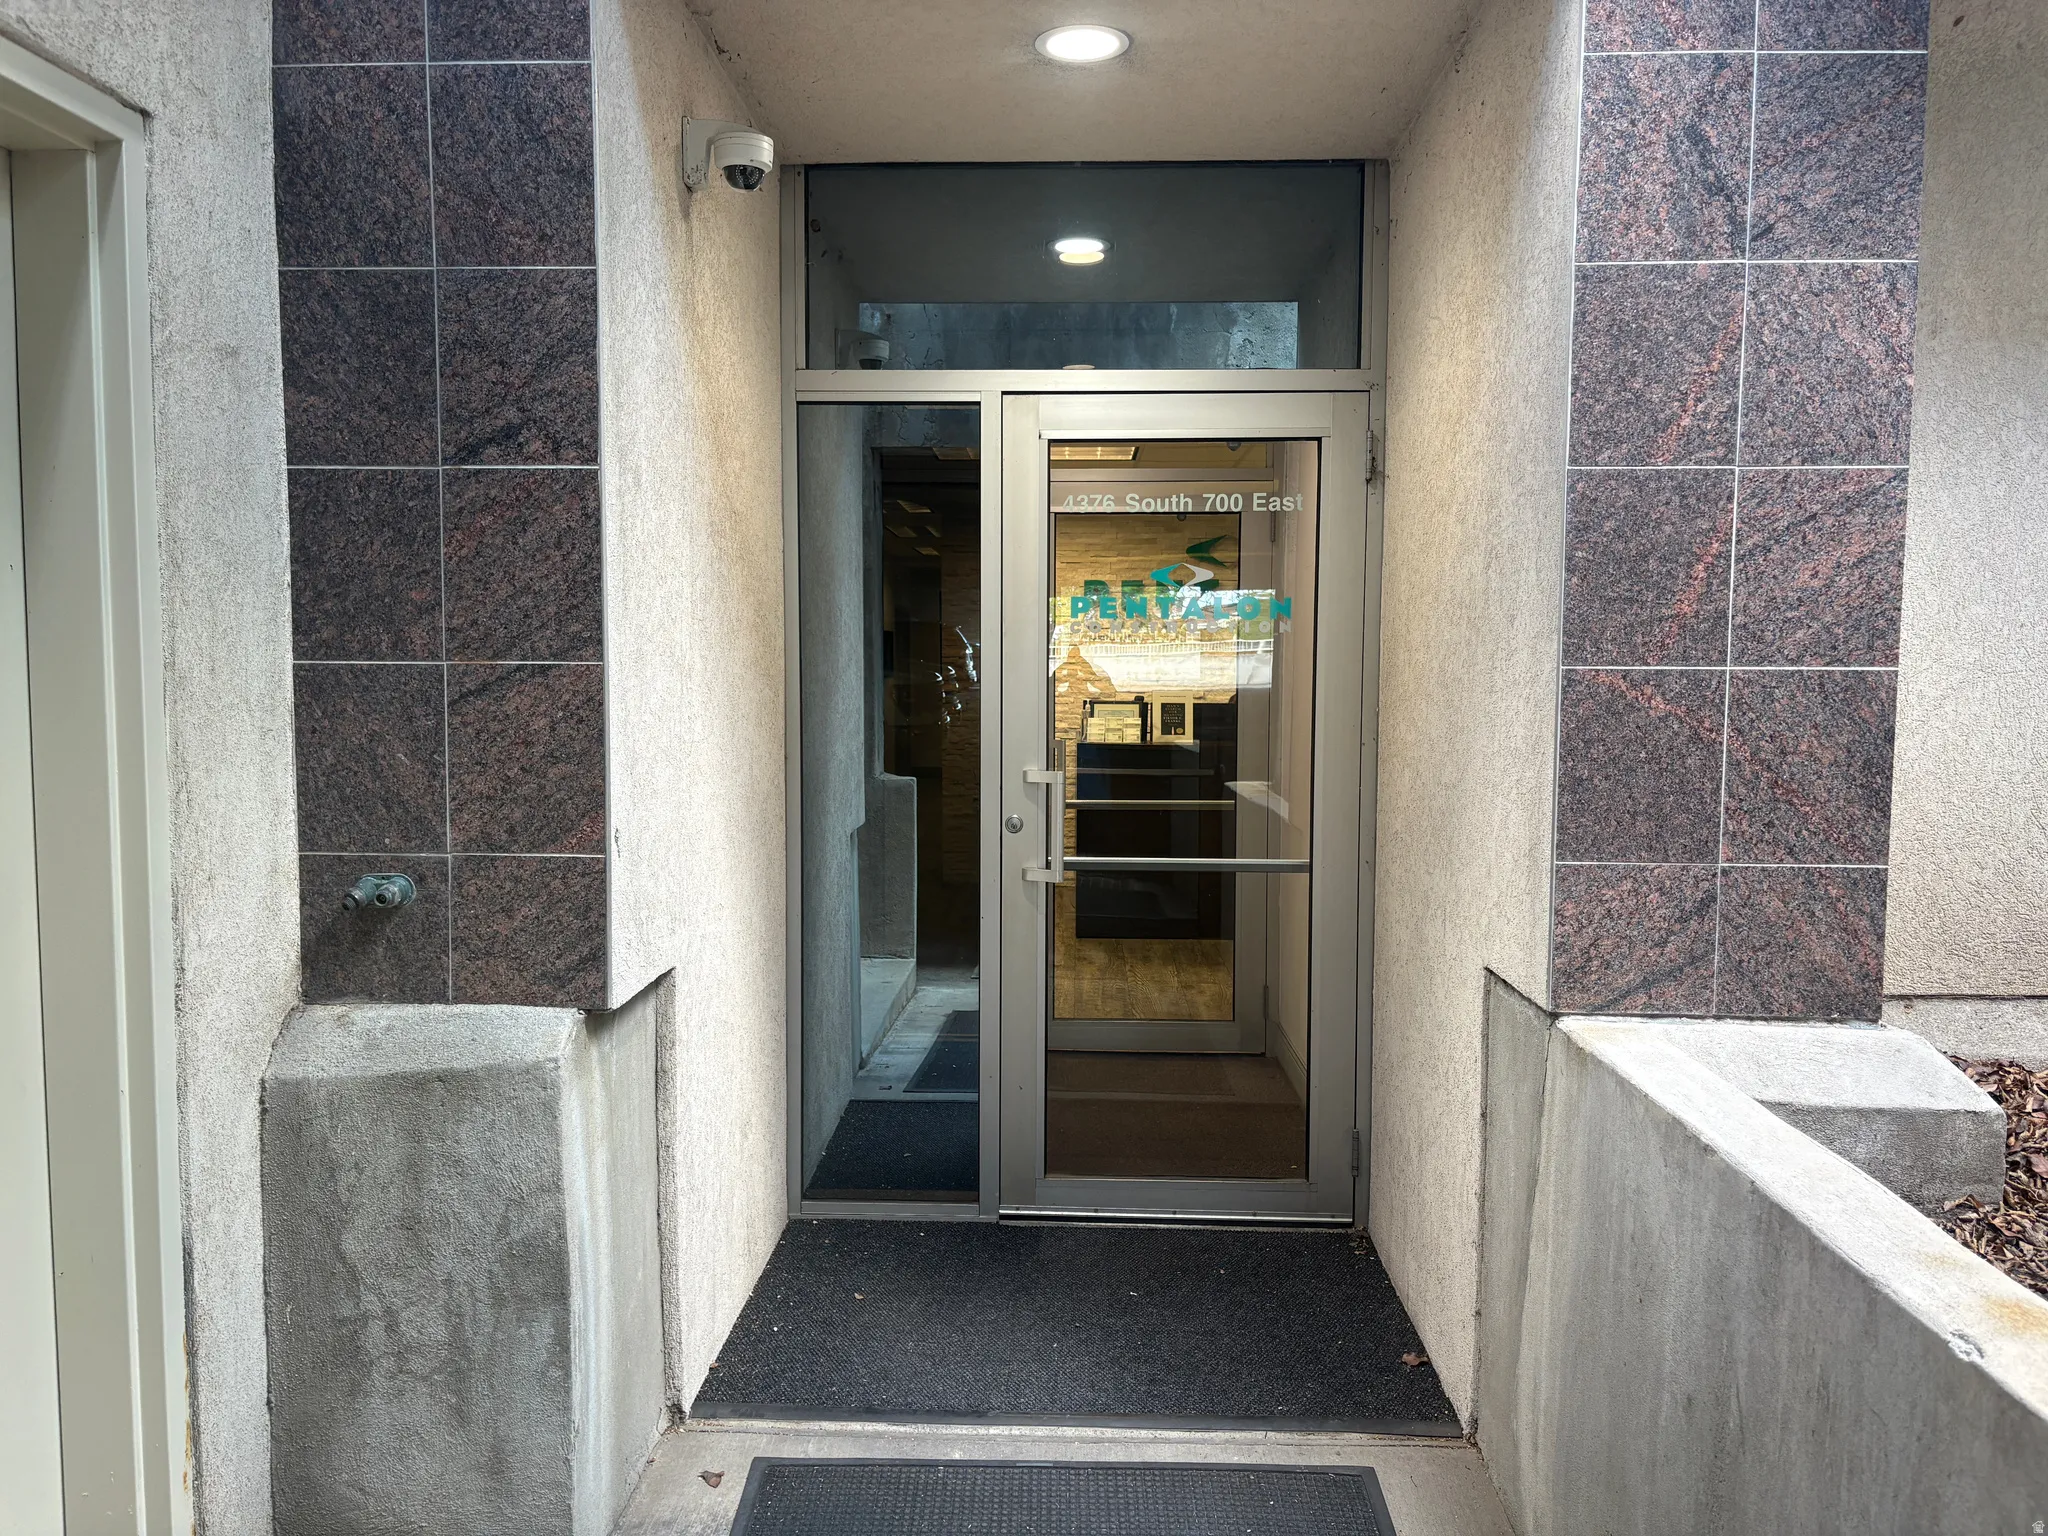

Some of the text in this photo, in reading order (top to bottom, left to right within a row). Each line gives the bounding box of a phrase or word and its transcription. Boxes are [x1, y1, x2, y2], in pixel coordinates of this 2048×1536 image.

[1062, 492, 1303, 513] 4376 South 700 East
[1070, 596, 1292, 620] PENTALON
[1069, 620, 1292, 634] CONSTRUCTION
